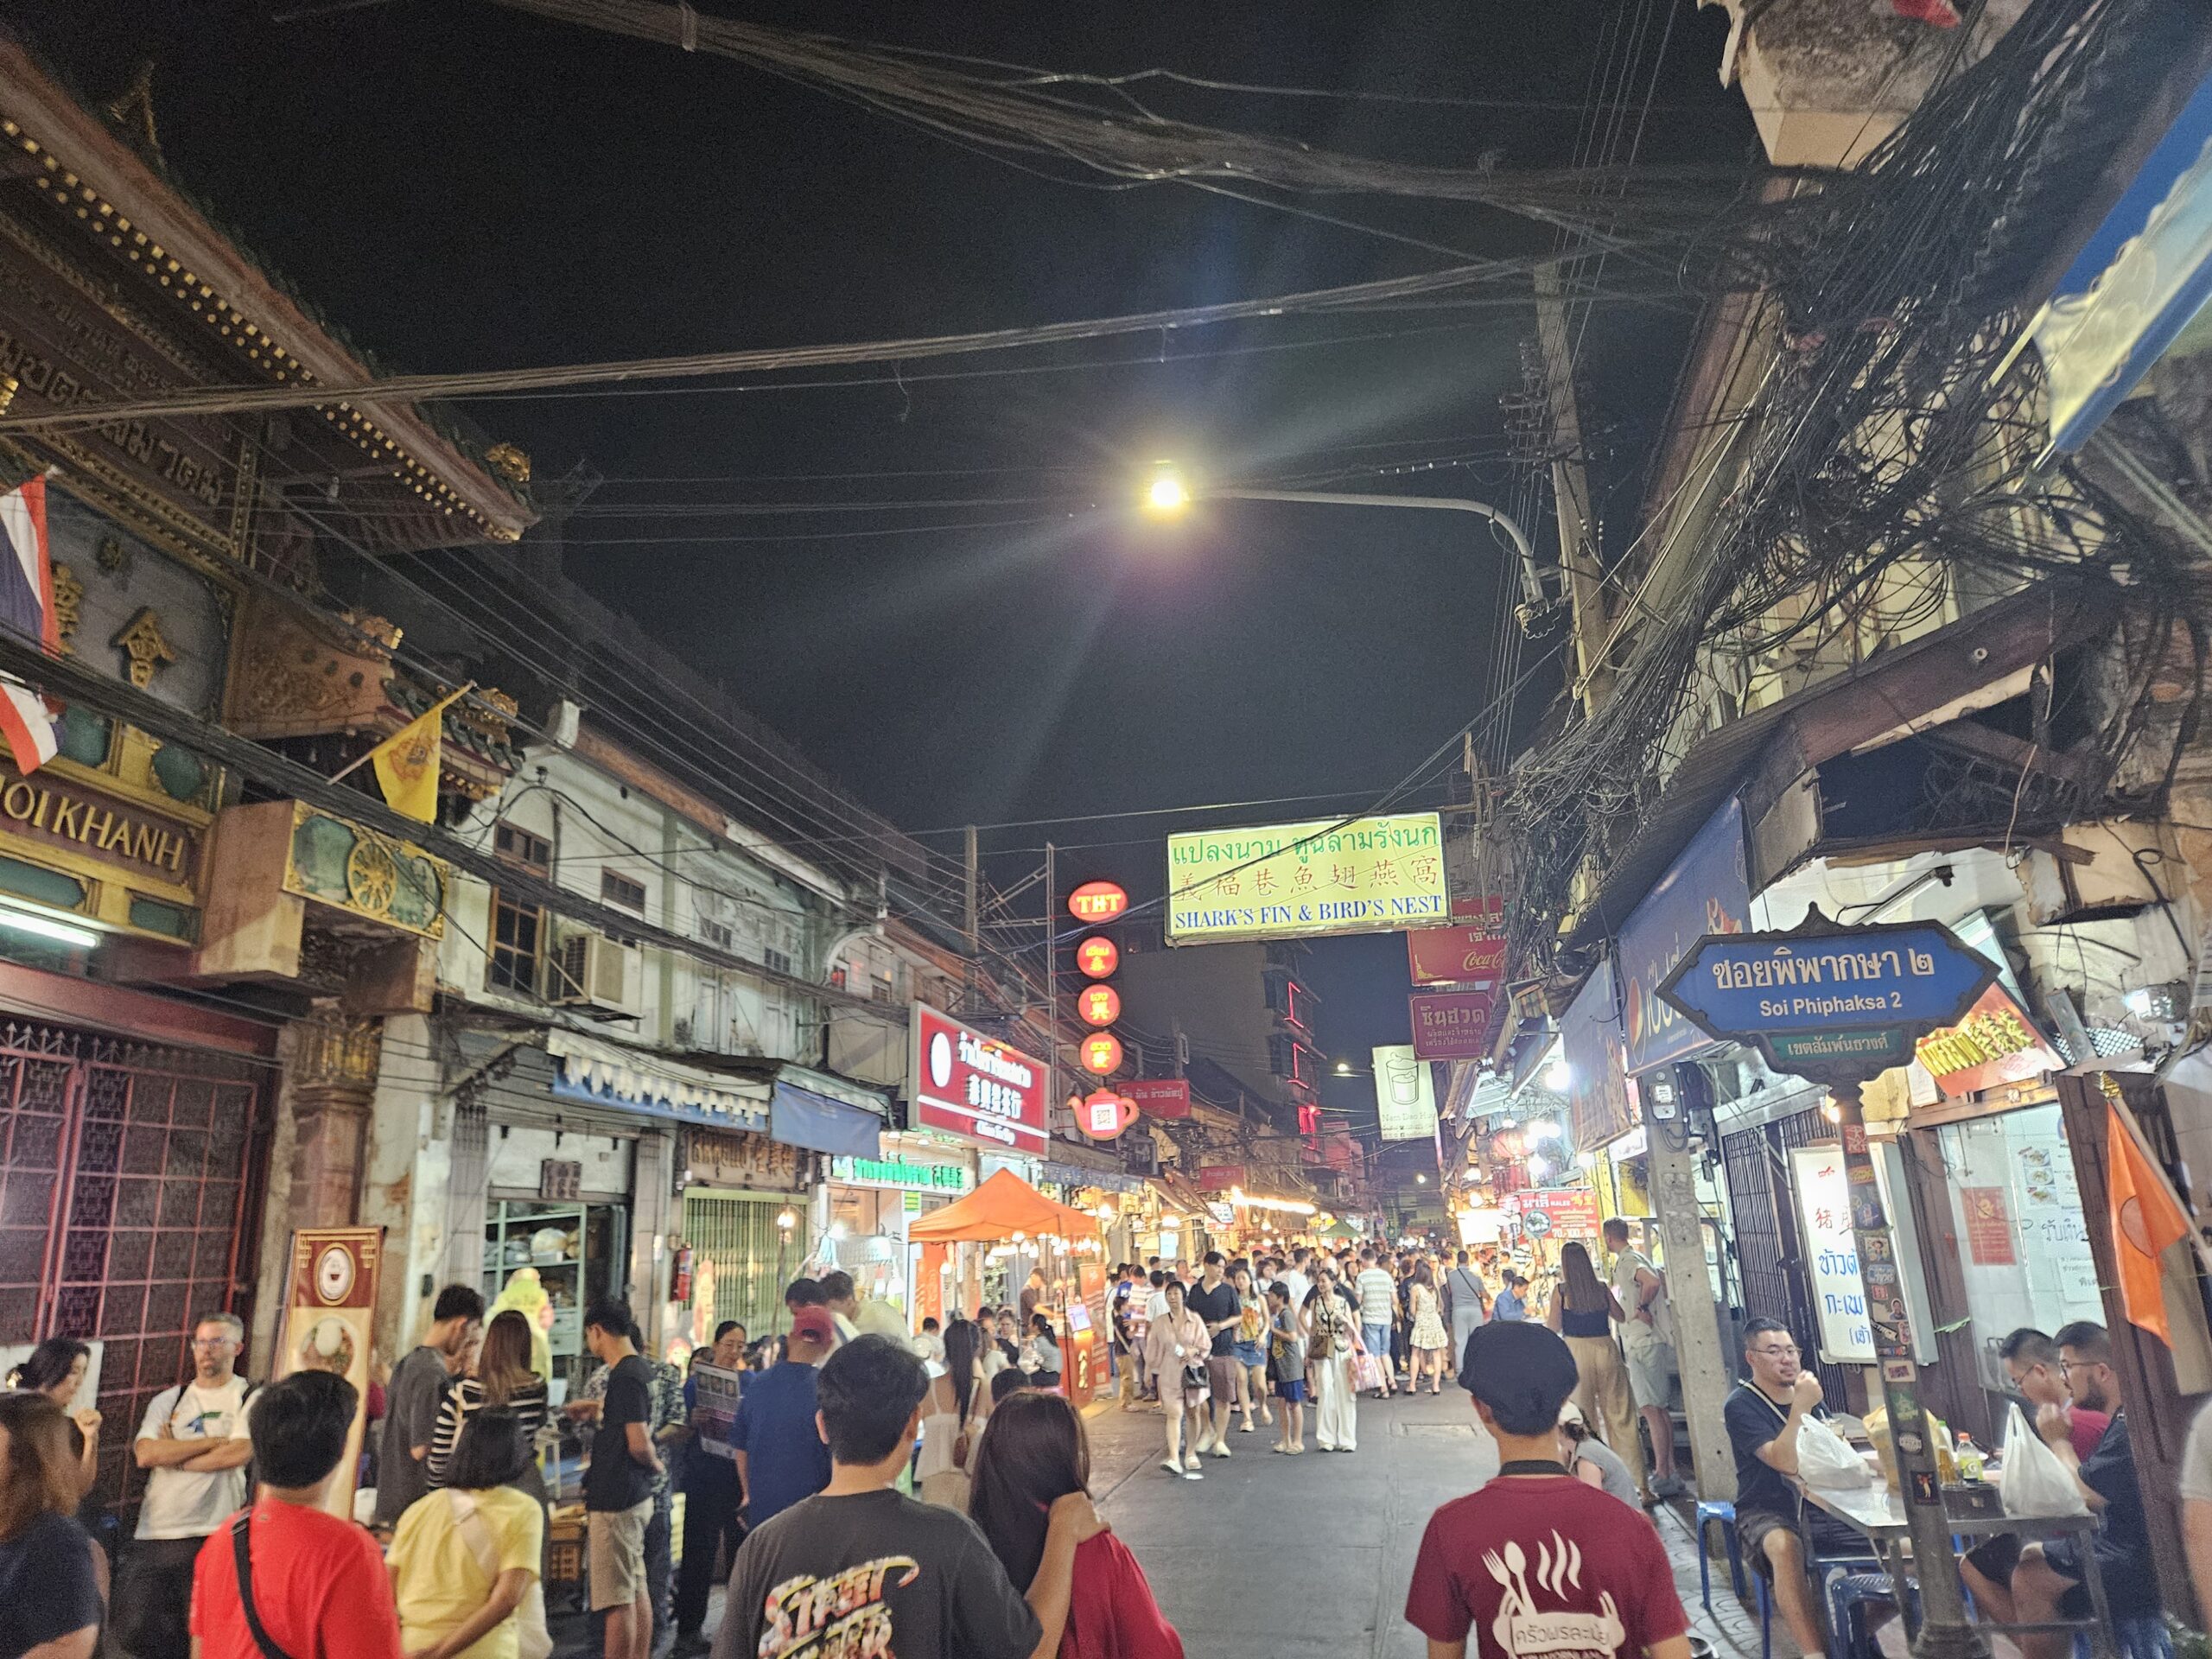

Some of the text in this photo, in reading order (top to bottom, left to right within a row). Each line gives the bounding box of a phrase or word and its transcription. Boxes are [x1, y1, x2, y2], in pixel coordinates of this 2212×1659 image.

[0, 775, 184, 872] OI KHANH
[1173, 838, 1281, 865] แปลงนาม
[1175, 894, 1442, 929] SHARK'S FIN & BIRD'S NEST
[1712, 946, 1936, 989] ซอยพิพากษา ๒
[1760, 992, 1903, 1017] Soi Phiphaksa 2
[1788, 1032, 1889, 1056] เขตสัมพันธวงศ์
